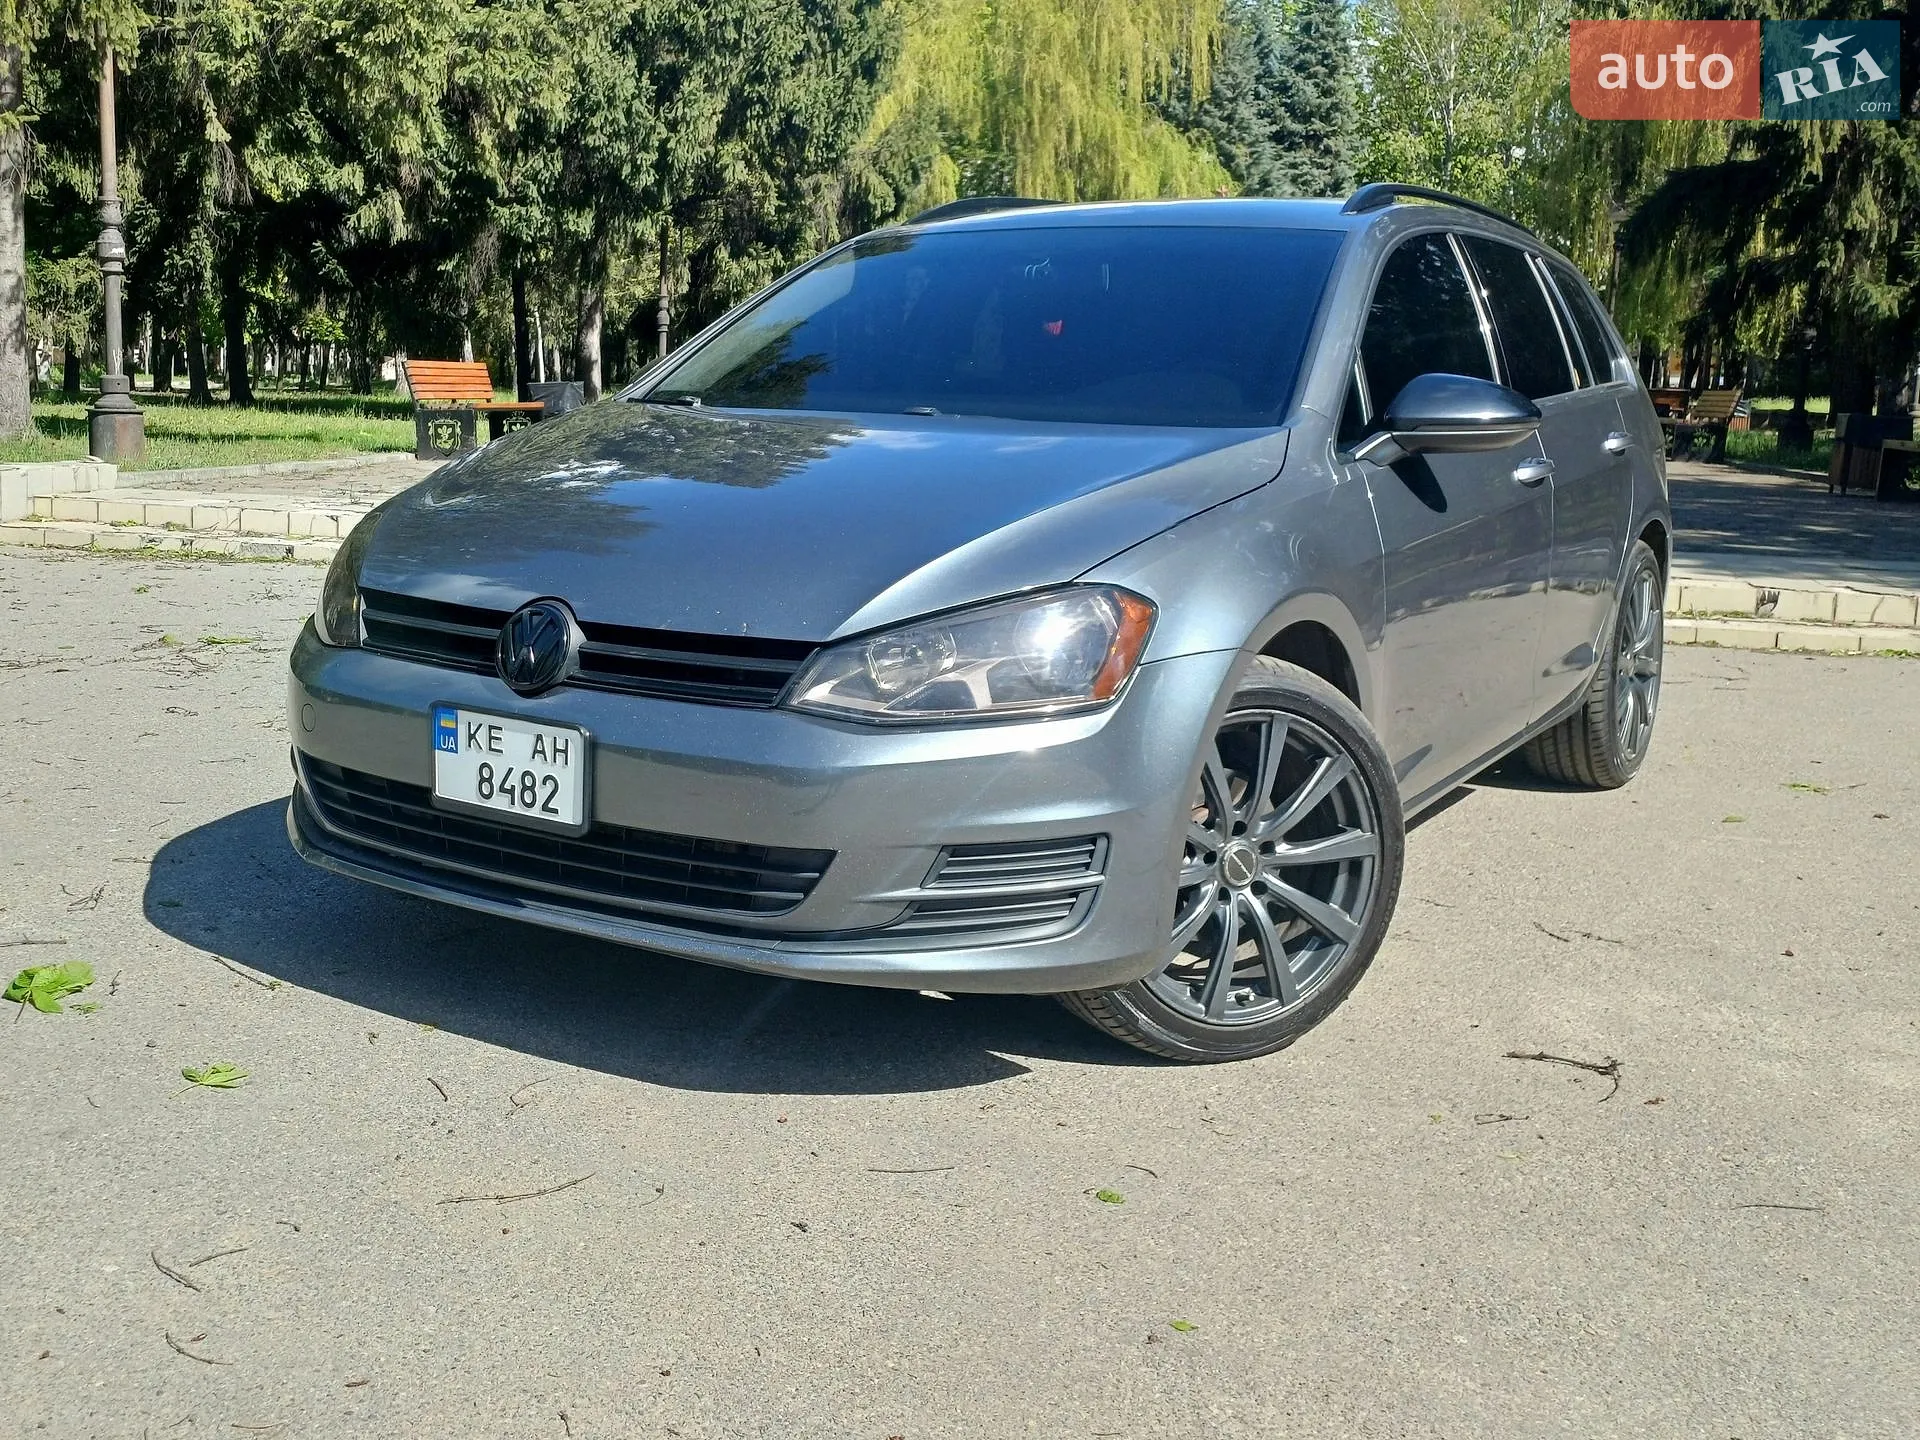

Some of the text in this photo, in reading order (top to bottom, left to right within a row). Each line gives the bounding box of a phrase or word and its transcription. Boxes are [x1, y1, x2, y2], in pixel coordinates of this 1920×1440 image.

[440, 736, 456, 751] UA
[467, 721, 569, 766] KE AH
[478, 761, 560, 815] 8482
